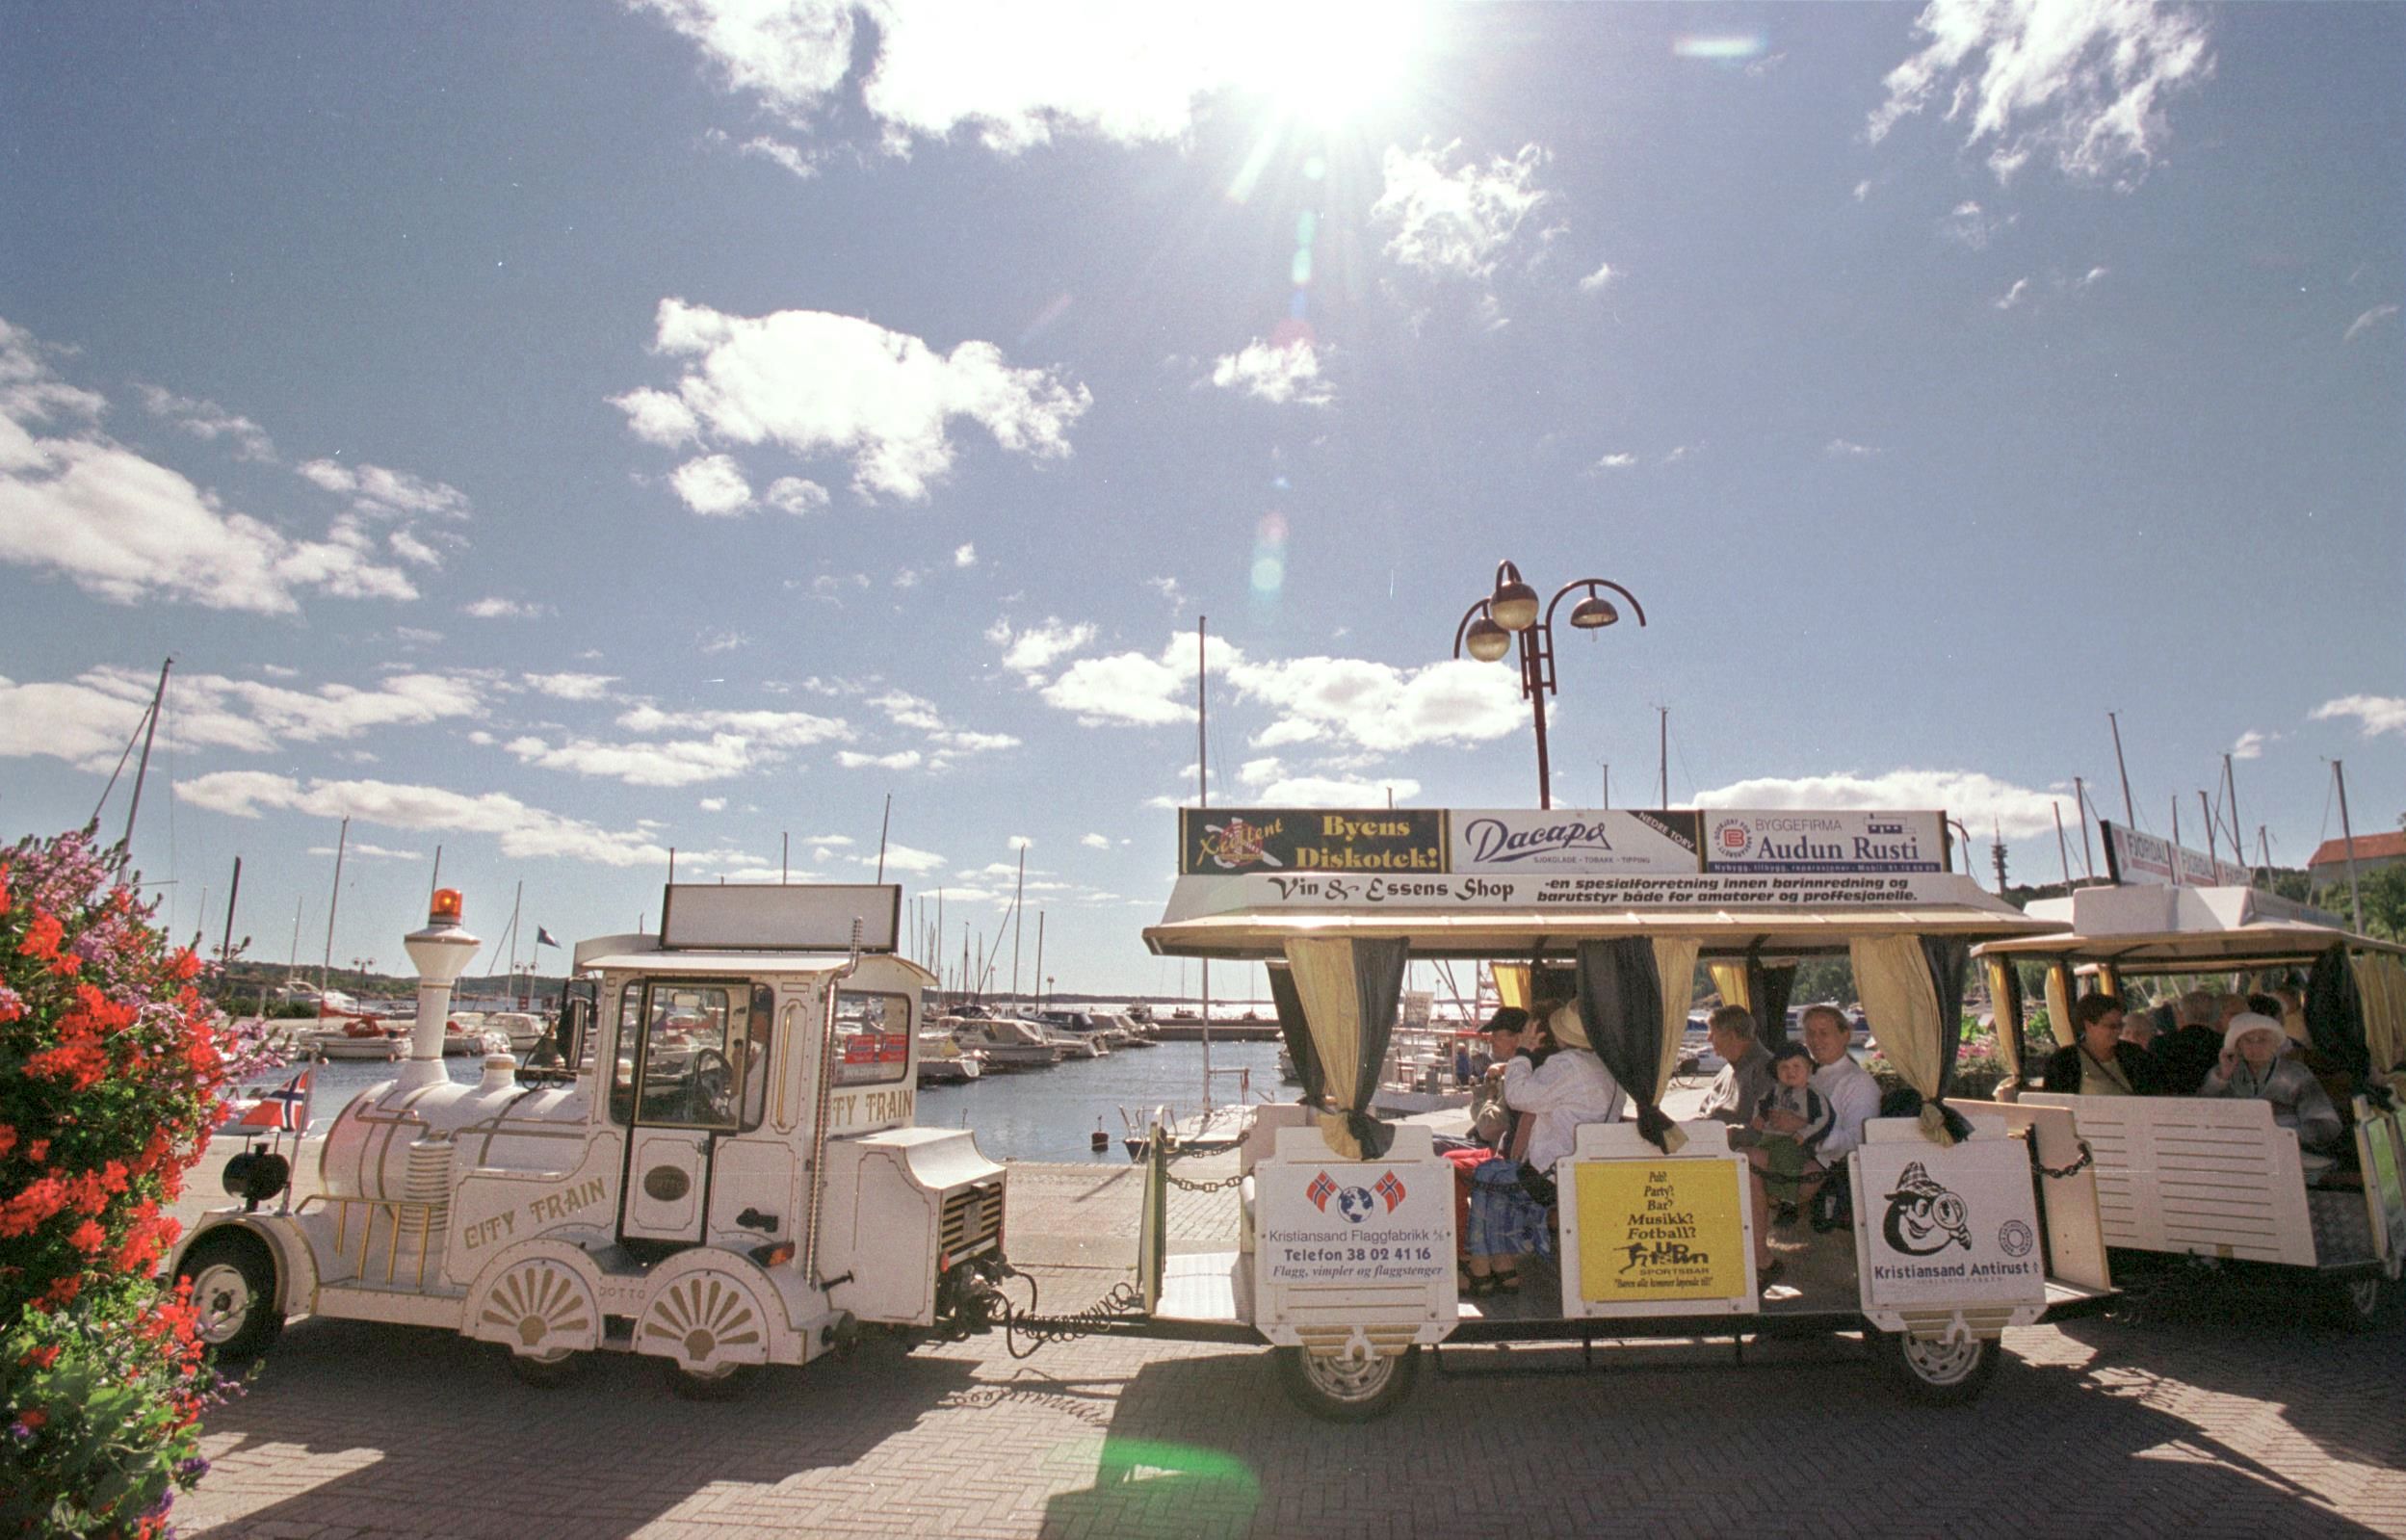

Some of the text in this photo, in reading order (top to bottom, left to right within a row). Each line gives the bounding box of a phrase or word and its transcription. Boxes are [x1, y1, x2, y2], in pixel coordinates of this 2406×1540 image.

[1322, 815, 1410, 842] Byens
[1638, 811, 1694, 851] NEDRE TORV
[1755, 818, 1843, 832] BYGGEFIRMA
[1465, 819, 1612, 864] Dacapo
[1756, 834, 1920, 860] Audun Rusti
[1295, 846, 1439, 869] Diskotek!
[1533, 856, 1578, 865] SJOKOLADE
[1268, 877, 1514, 901] Vin & Essens Shop
[1575, 878, 1718, 891] spesialforretning
[1723, 878, 1767, 889] innen
[1772, 878, 1885, 890] barinnredning
[1889, 879, 1909, 890] og
[1536, 891, 1618, 903] barutstyr
[1668, 891, 1693, 902] for
[1779, 892, 1798, 902] og
[1803, 891, 1918, 903] proffesjonelle.
[865, 1089, 914, 1123] TRAIN
[1643, 1186, 1675, 1199] Party?
[1646, 1200, 1674, 1212] Bar?
[462, 1177, 608, 1251] CITY TRAIN
[1627, 1213, 1694, 1226] Musikk?
[1268, 1229, 1347, 1243] Kristiansand
[1351, 1229, 1430, 1245] Flaggfabrikk
[1627, 1227, 1697, 1240] Fotball?
[1284, 1247, 1431, 1262] Telefon 38 02 41 16
[1272, 1264, 1444, 1279] Flagg, vimpler og flaggstenger
[1639, 1267, 1711, 1276] SPORTSBAR
[1874, 1264, 1965, 1280] Kristiansand
[1971, 1262, 2029, 1276] Antirust
[598, 1286, 646, 1300] DOTTO
